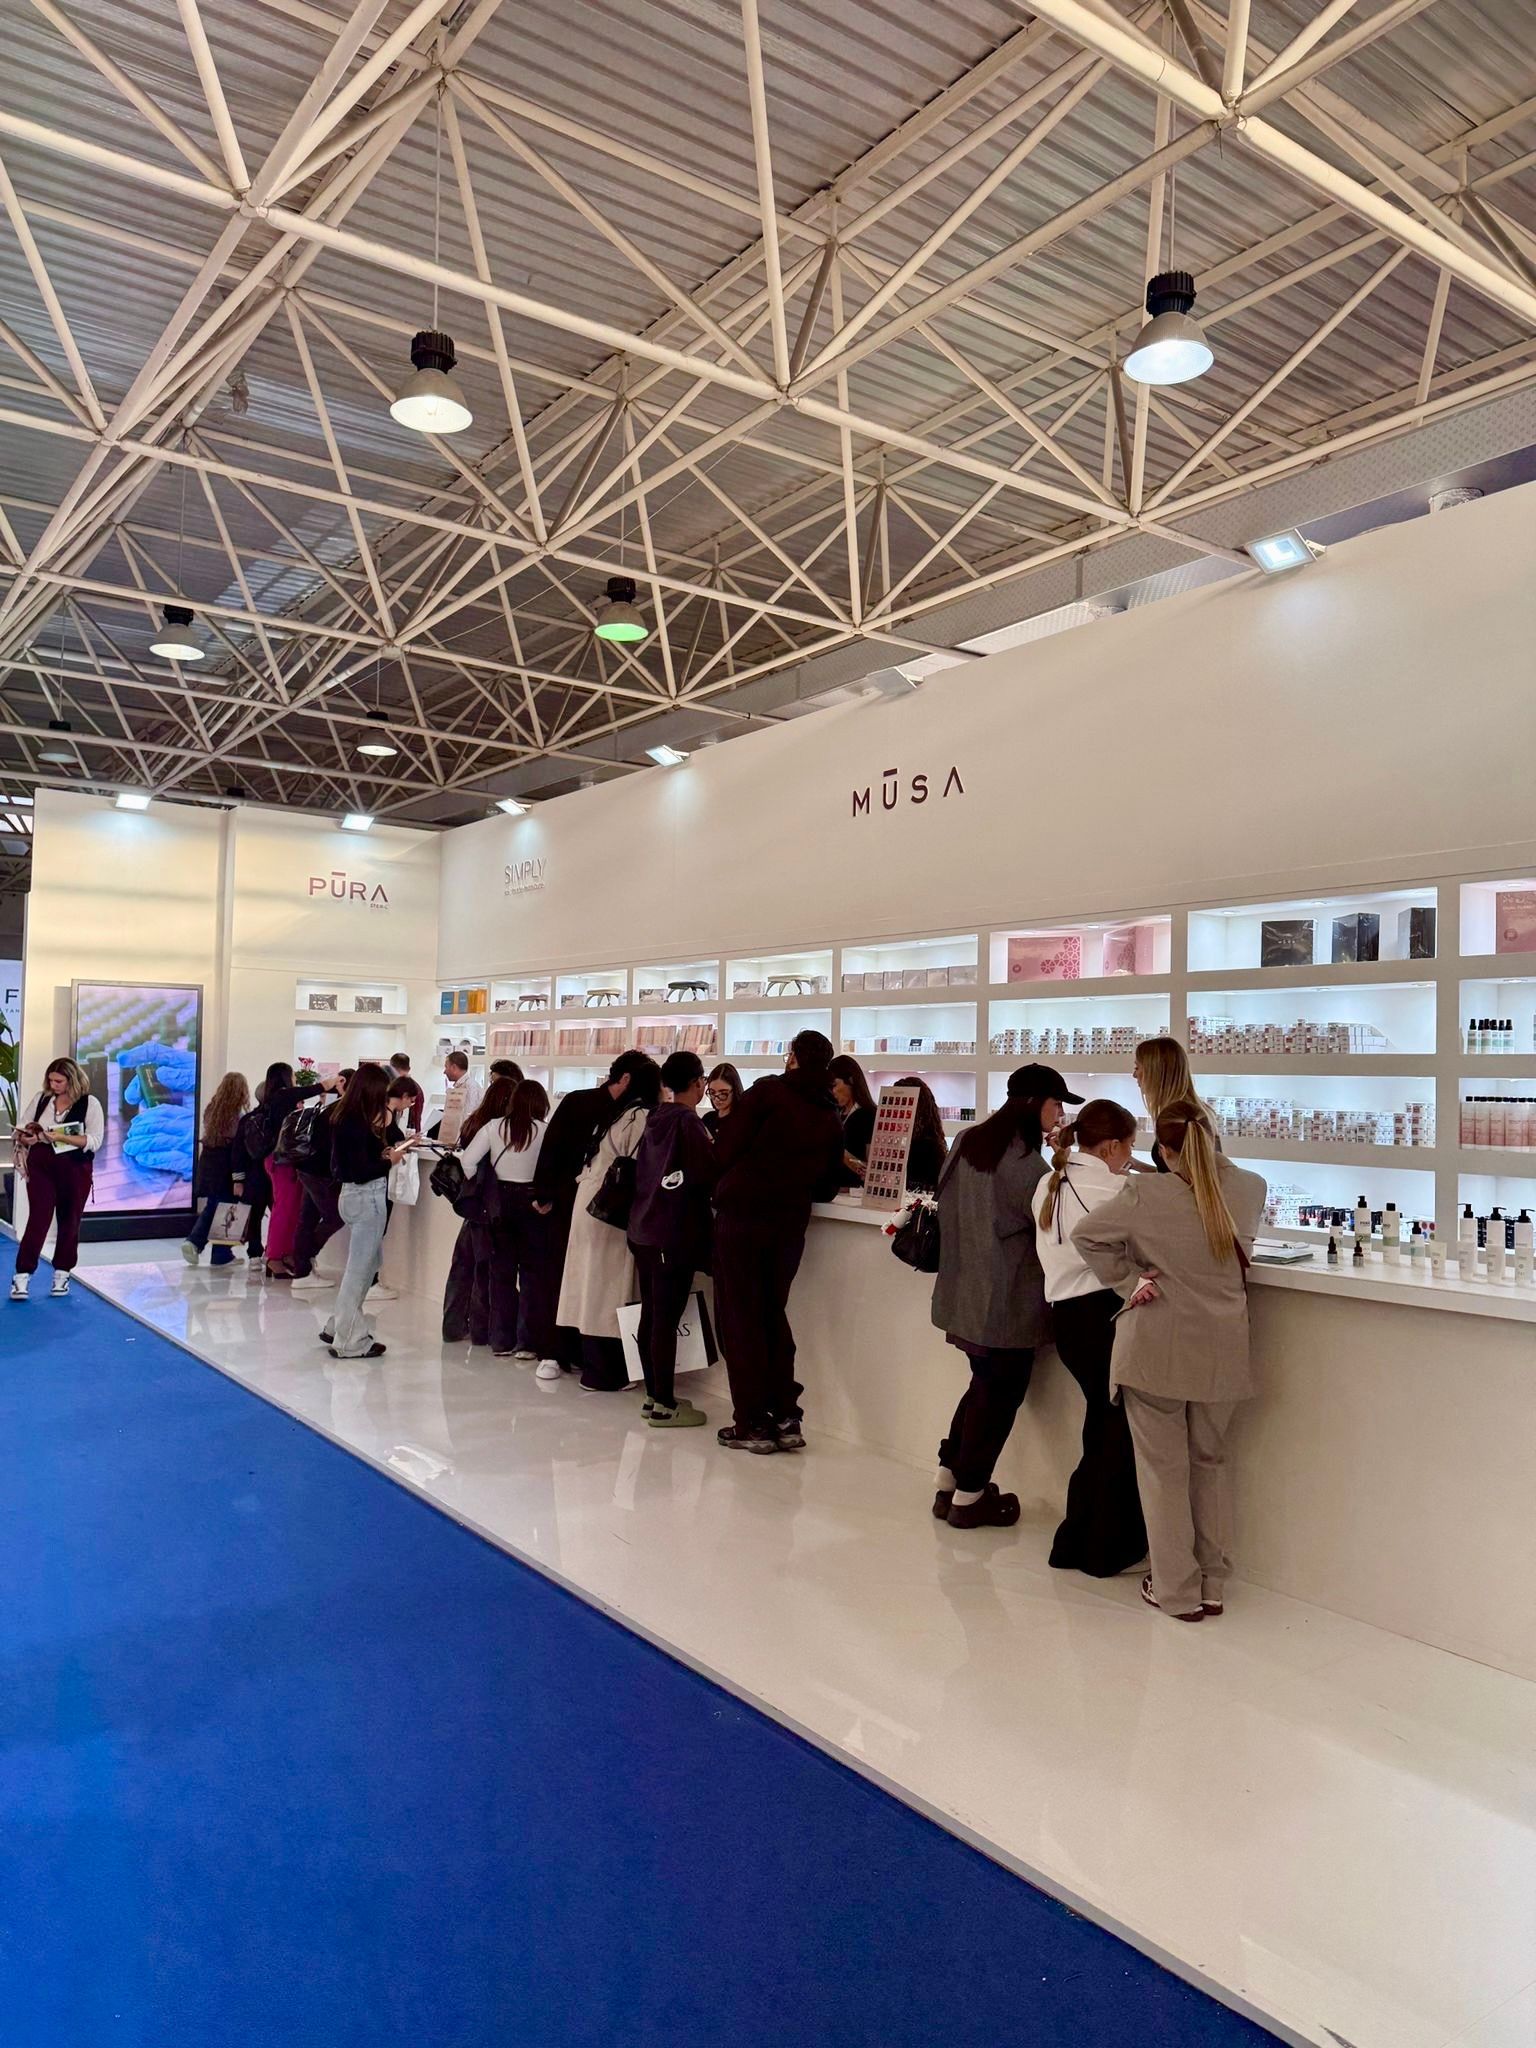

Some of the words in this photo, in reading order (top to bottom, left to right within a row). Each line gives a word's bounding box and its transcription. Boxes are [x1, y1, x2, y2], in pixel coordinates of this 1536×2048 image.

[853, 766, 964, 817] MŪSA
[309, 871, 388, 902] PŪRA
[504, 858, 547, 885] SIMPLY
